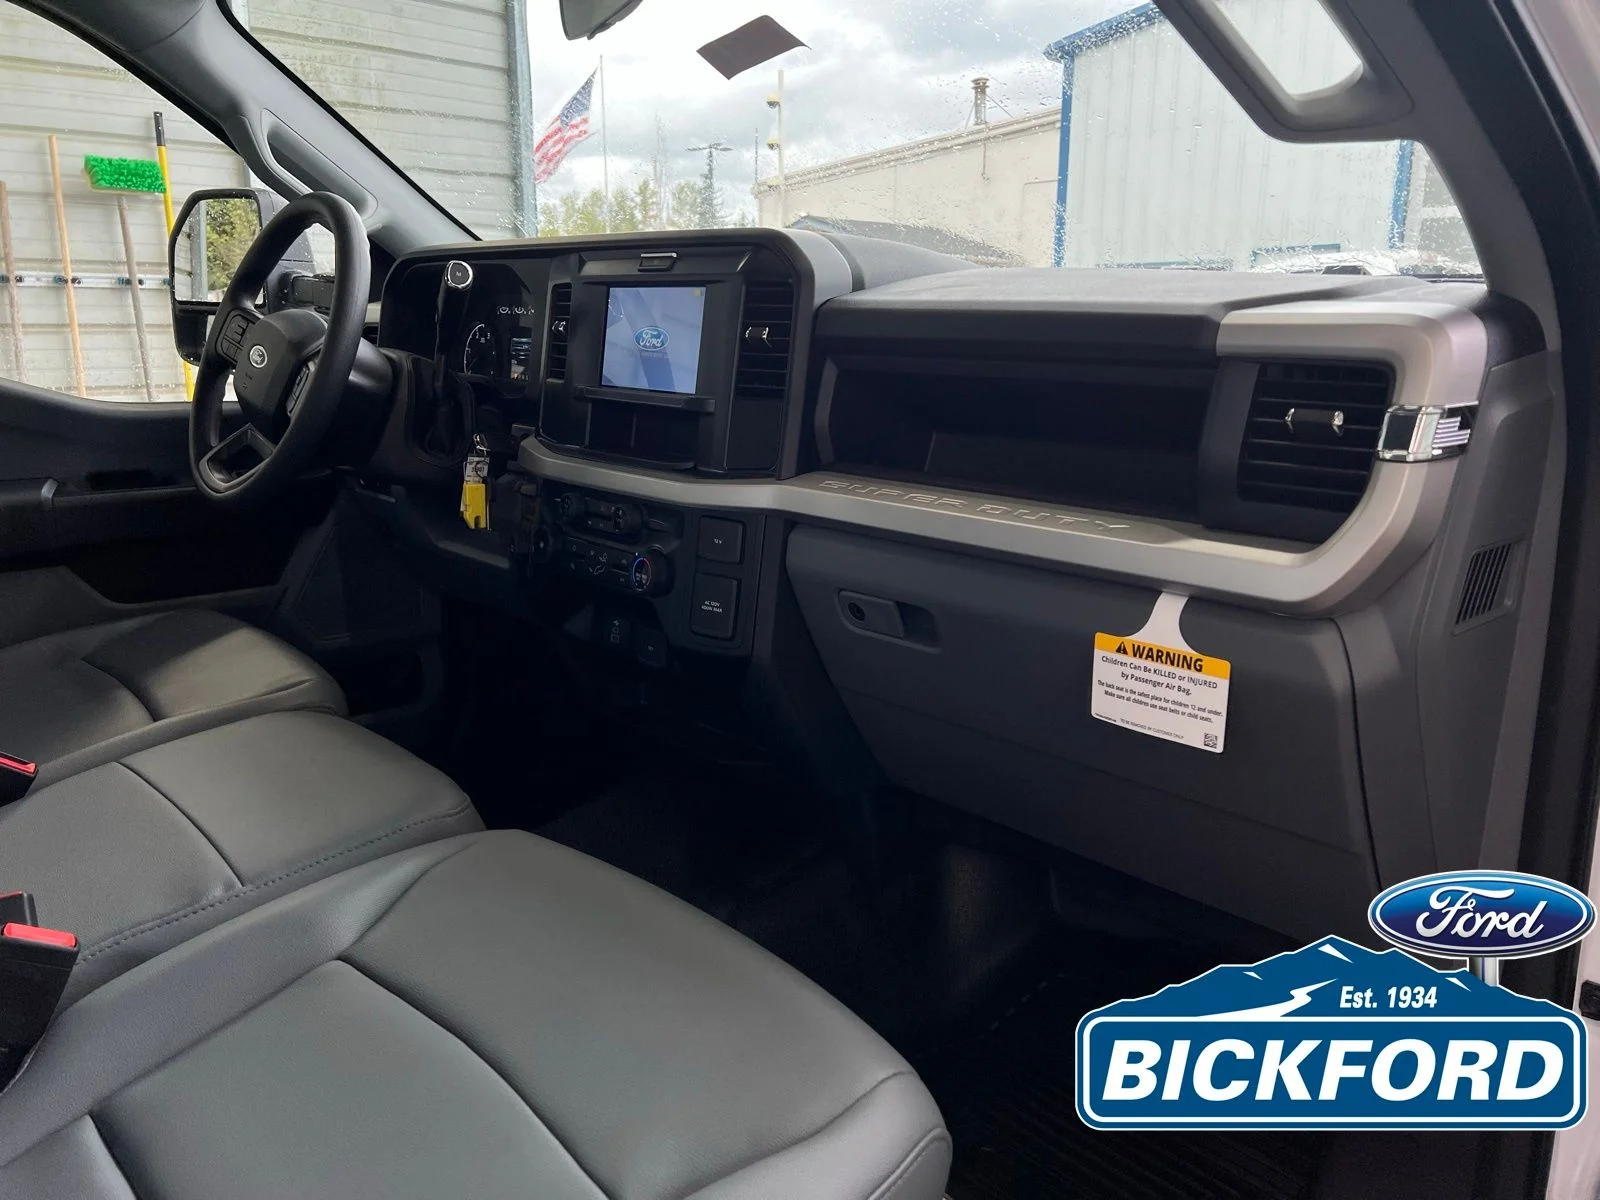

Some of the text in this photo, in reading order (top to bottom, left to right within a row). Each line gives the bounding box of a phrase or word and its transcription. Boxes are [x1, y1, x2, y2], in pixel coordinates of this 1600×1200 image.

[639, 329, 664, 347] Ford
[819, 480, 1130, 530] SUPER DUTY
[1132, 643, 1203, 672] WARNING
[1102, 656, 1128, 668] Children
[1129, 662, 1142, 671] Can
[1153, 668, 1176, 679] KILLED
[1188, 676, 1217, 689] INJURED
[1121, 671, 1129, 680] by
[1130, 674, 1164, 688] Passenger
[1177, 686, 1192, 696] Bag.
[1132, 698, 1149, 706] children
[1169, 707, 1180, 715] belts
[1138, 690, 1150, 698] safest
[1151, 694, 1162, 702] place
[1171, 699, 1189, 709] children
